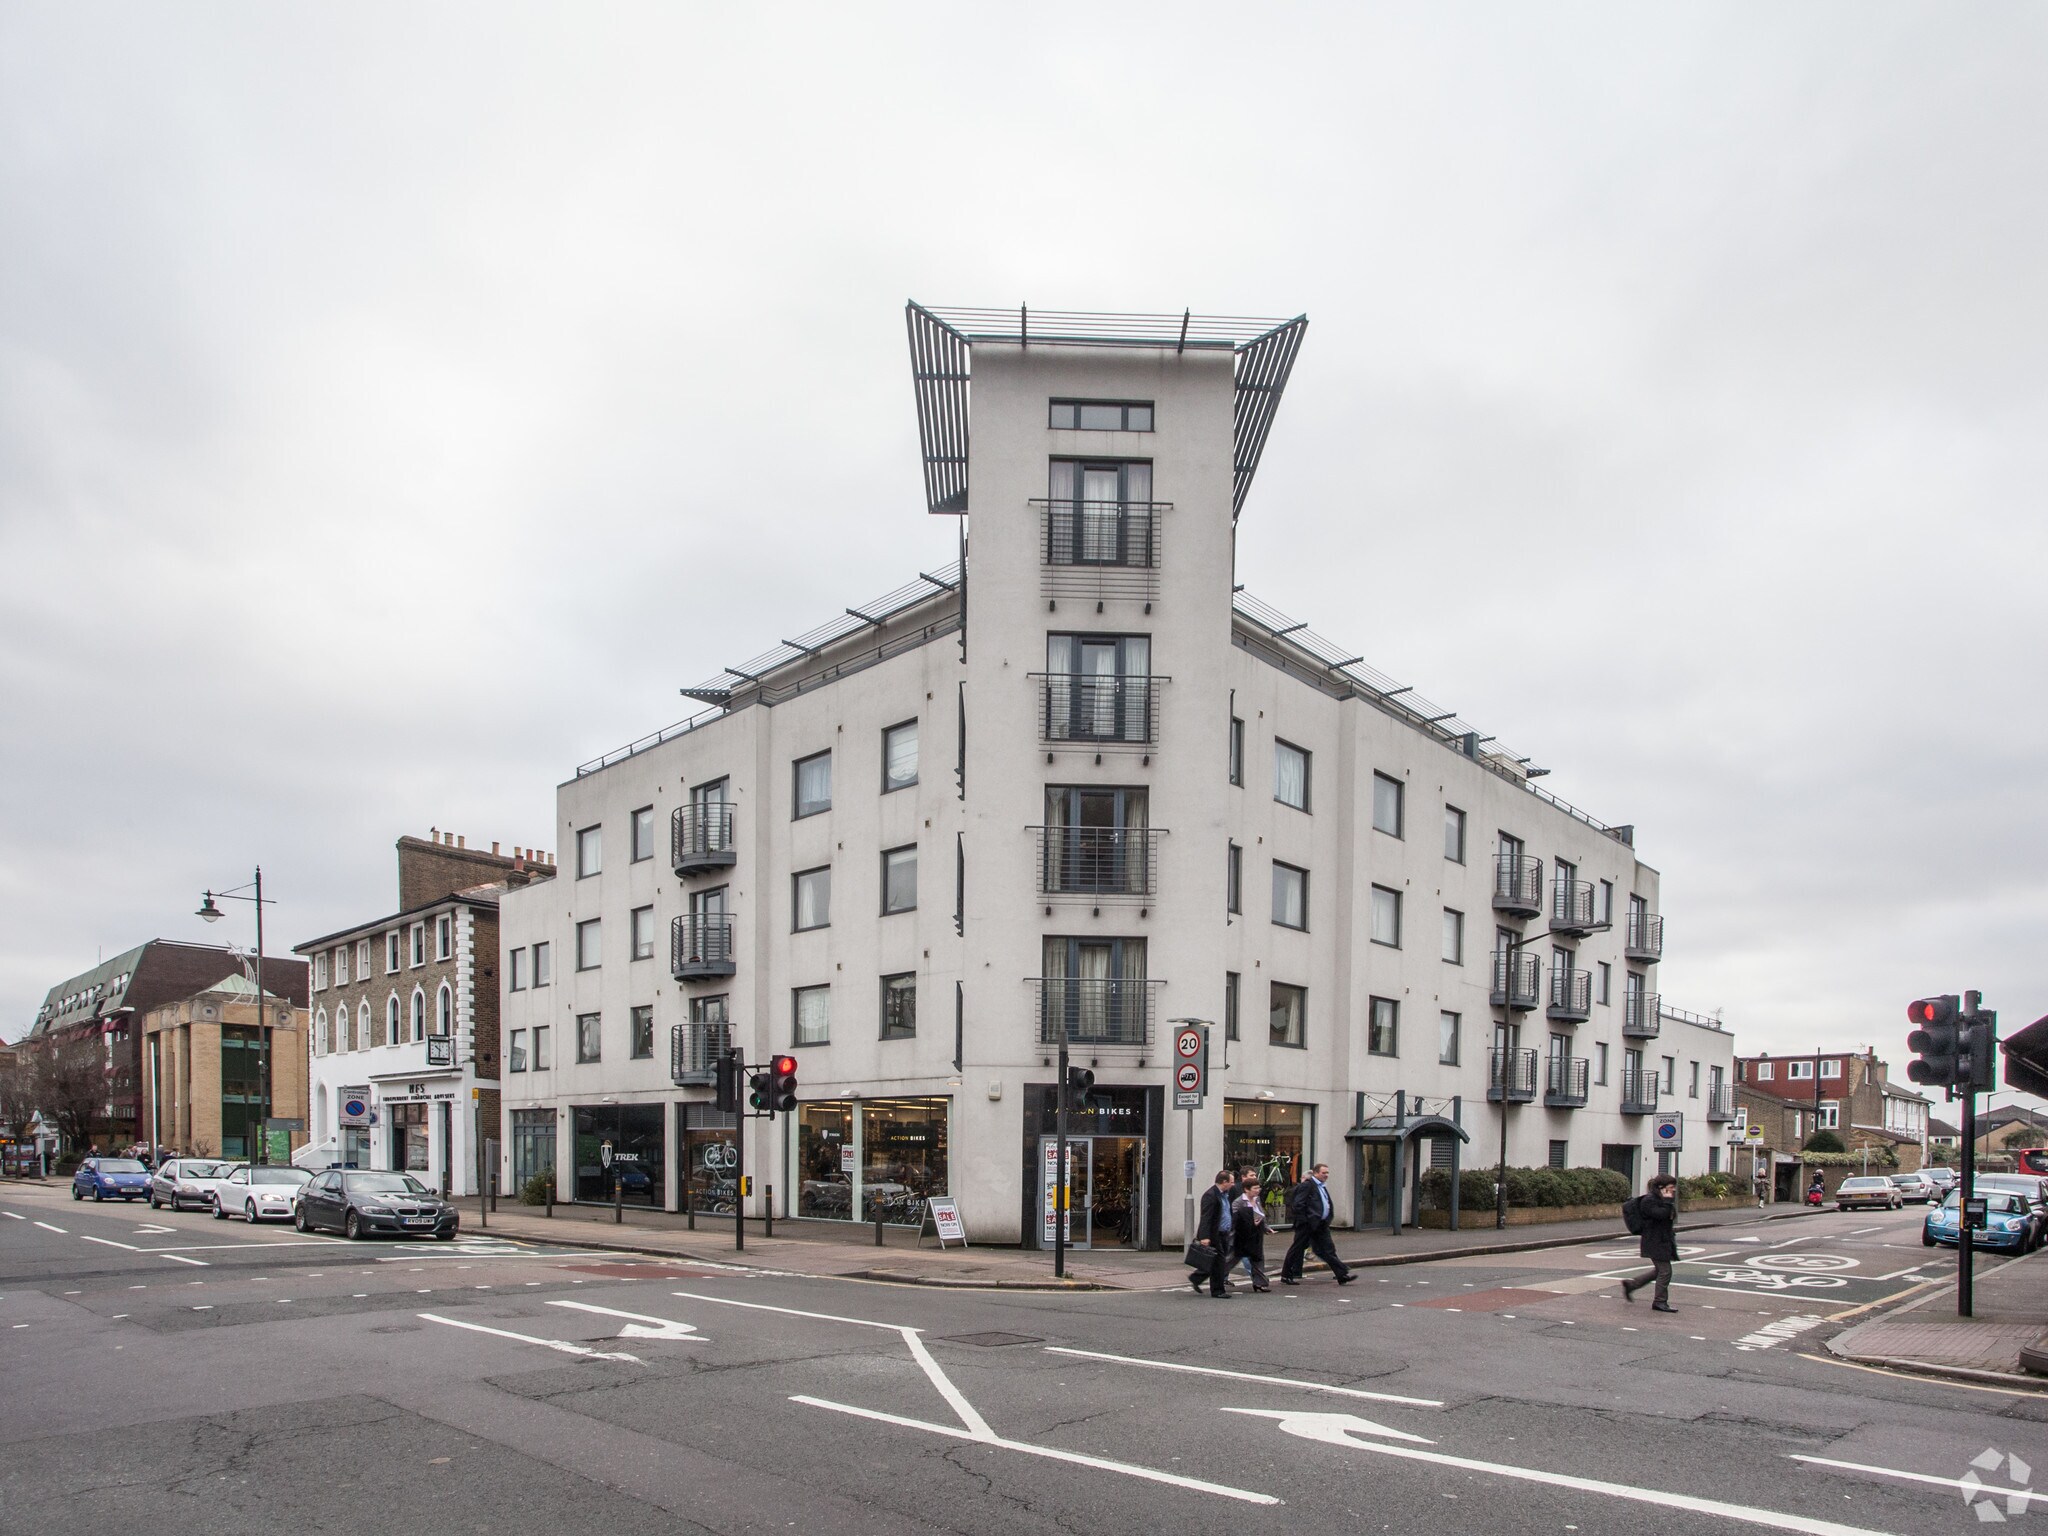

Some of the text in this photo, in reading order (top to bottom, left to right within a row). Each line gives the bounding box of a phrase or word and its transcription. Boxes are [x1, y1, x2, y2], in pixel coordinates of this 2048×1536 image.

[1181, 1037, 1197, 1050] 20
[614, 1153, 639, 1161] TREK
[1047, 1150, 1069, 1159] SAE
[906, 1199, 926, 1207] BIKE
[938, 1213, 956, 1221] SALE
